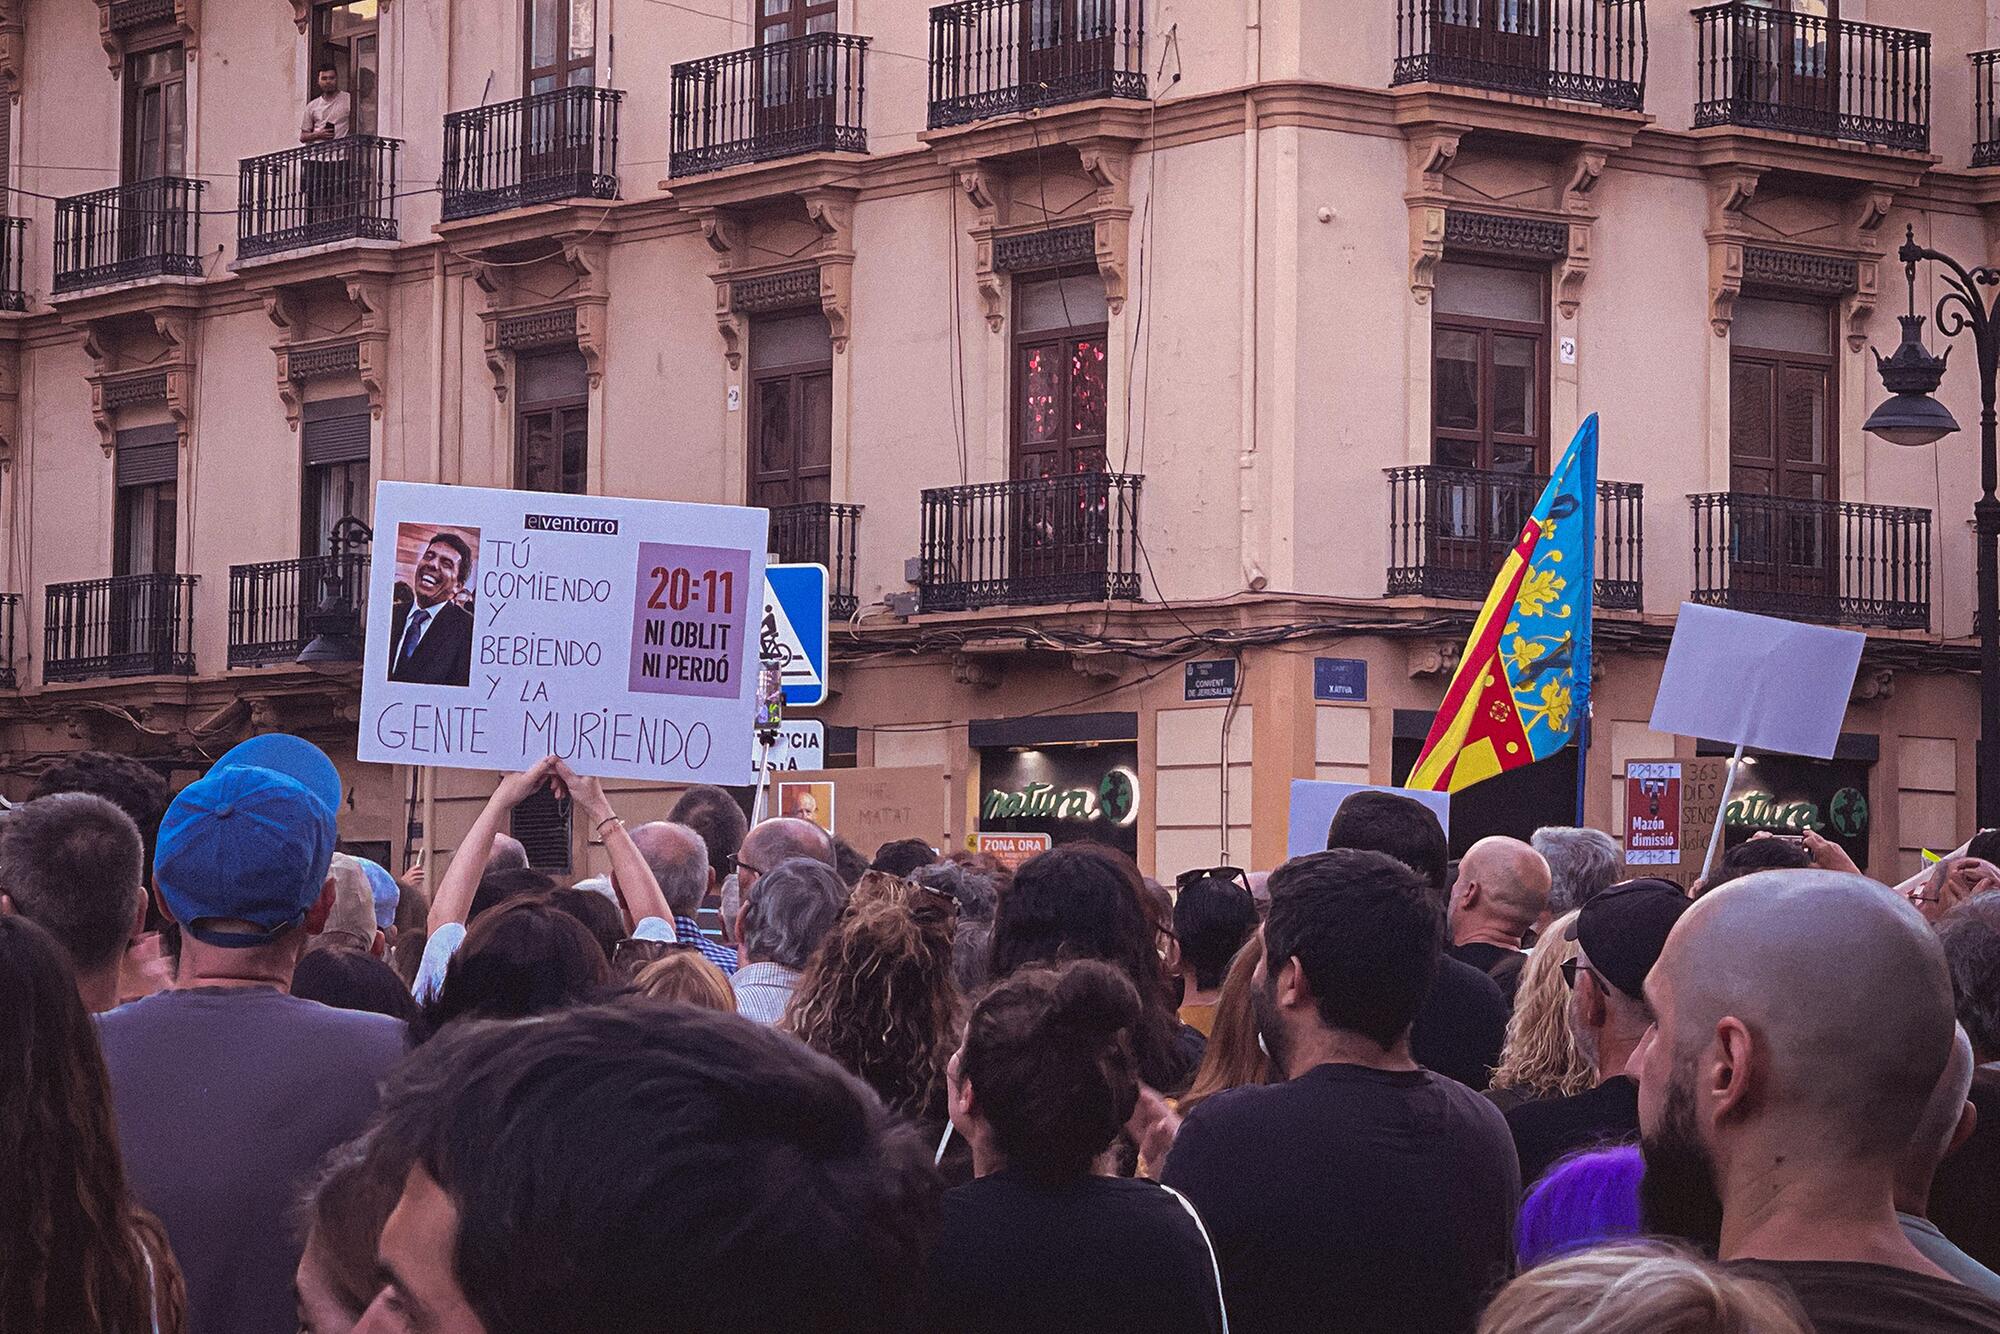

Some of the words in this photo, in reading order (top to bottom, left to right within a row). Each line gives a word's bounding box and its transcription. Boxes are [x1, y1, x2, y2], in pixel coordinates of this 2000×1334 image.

[486, 536, 530, 569] TÚ
[647, 566, 734, 614] 20:11
[488, 602, 506, 627] Y
[644, 618, 665, 646] NI
[670, 620, 731, 651] OBLIT
[641, 652, 661, 678] NI
[665, 653, 729, 684] PERDÓ
[486, 674, 501, 700] Y
[520, 680, 549, 702] LA
[376, 702, 488, 754] GENTE
[1689, 763, 1719, 781] 365
[983, 781, 1101, 821] natura
[1632, 815, 1665, 831] Mazón
[984, 839, 1014, 851] ZONA
[1018, 839, 1042, 851] ORA
[1631, 831, 1675, 847] dimissió
